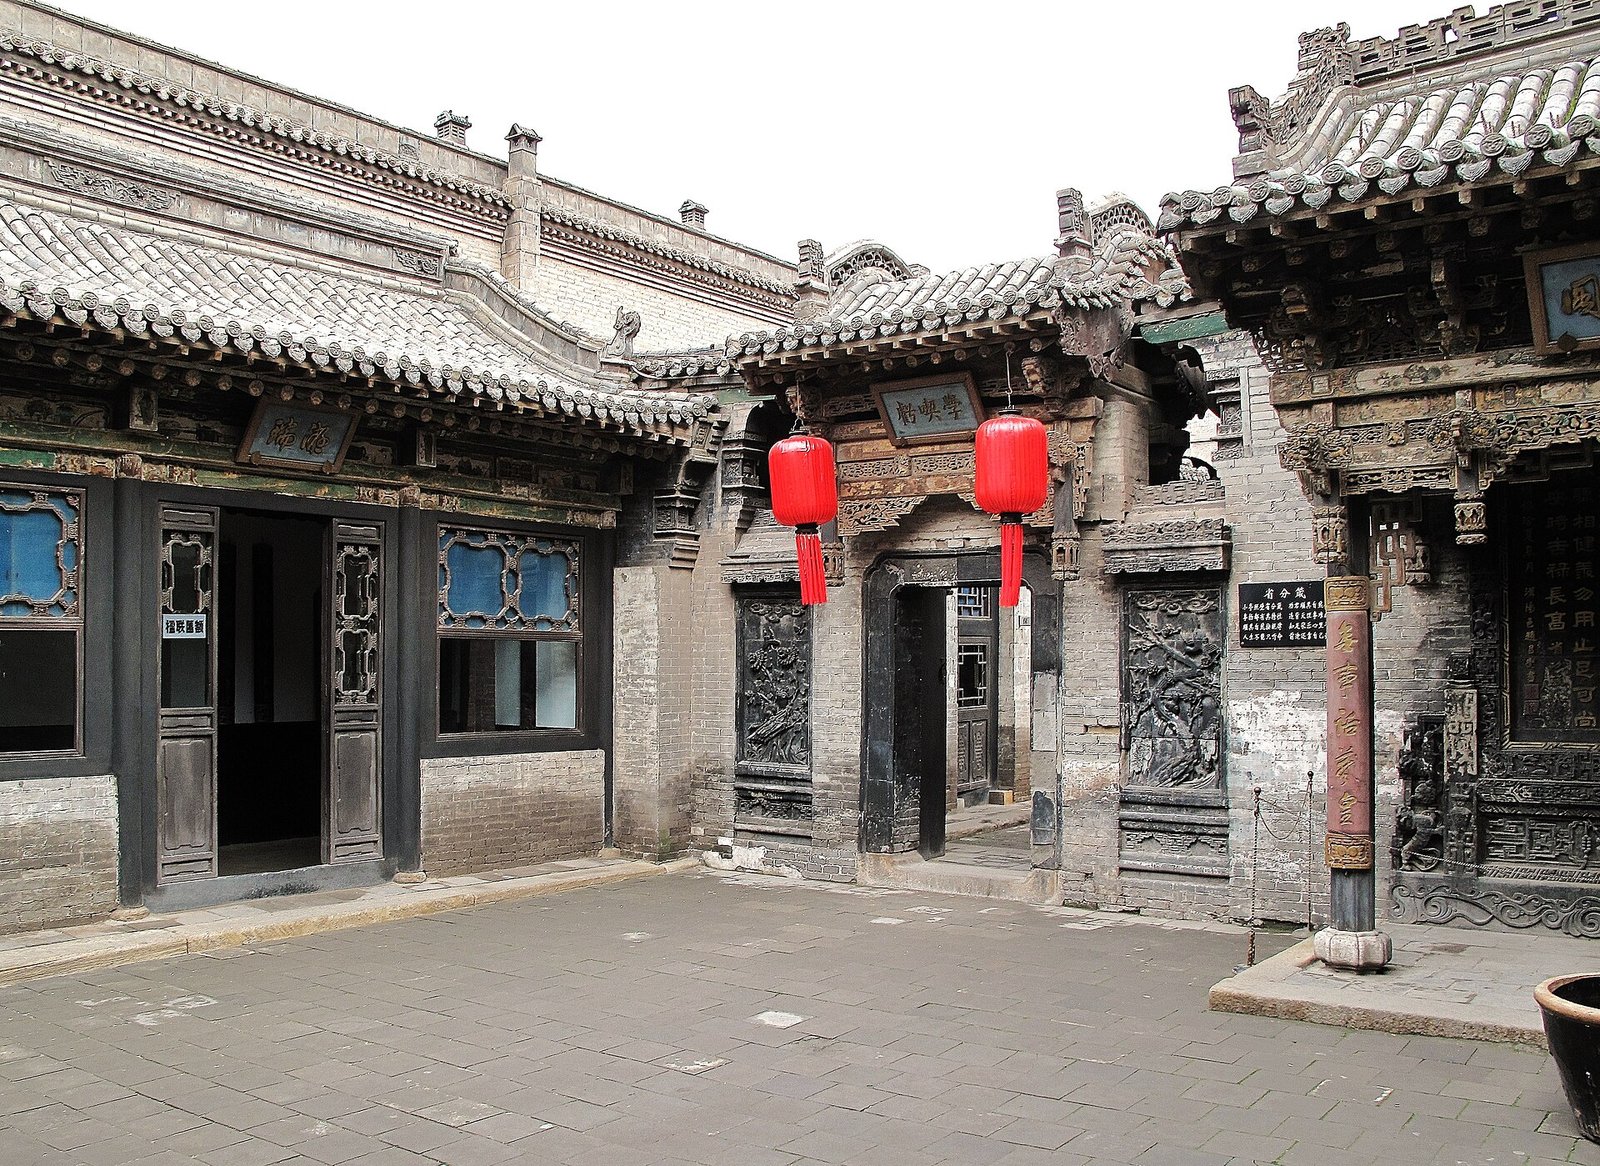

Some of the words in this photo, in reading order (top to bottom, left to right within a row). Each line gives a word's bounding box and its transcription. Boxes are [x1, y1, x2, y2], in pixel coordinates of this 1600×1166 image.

[1264, 587, 1307, 600] 省分箴
[1288, 600, 1325, 610] 功名顺其自然
[1288, 621, 1327, 631] 知足常乐心里
